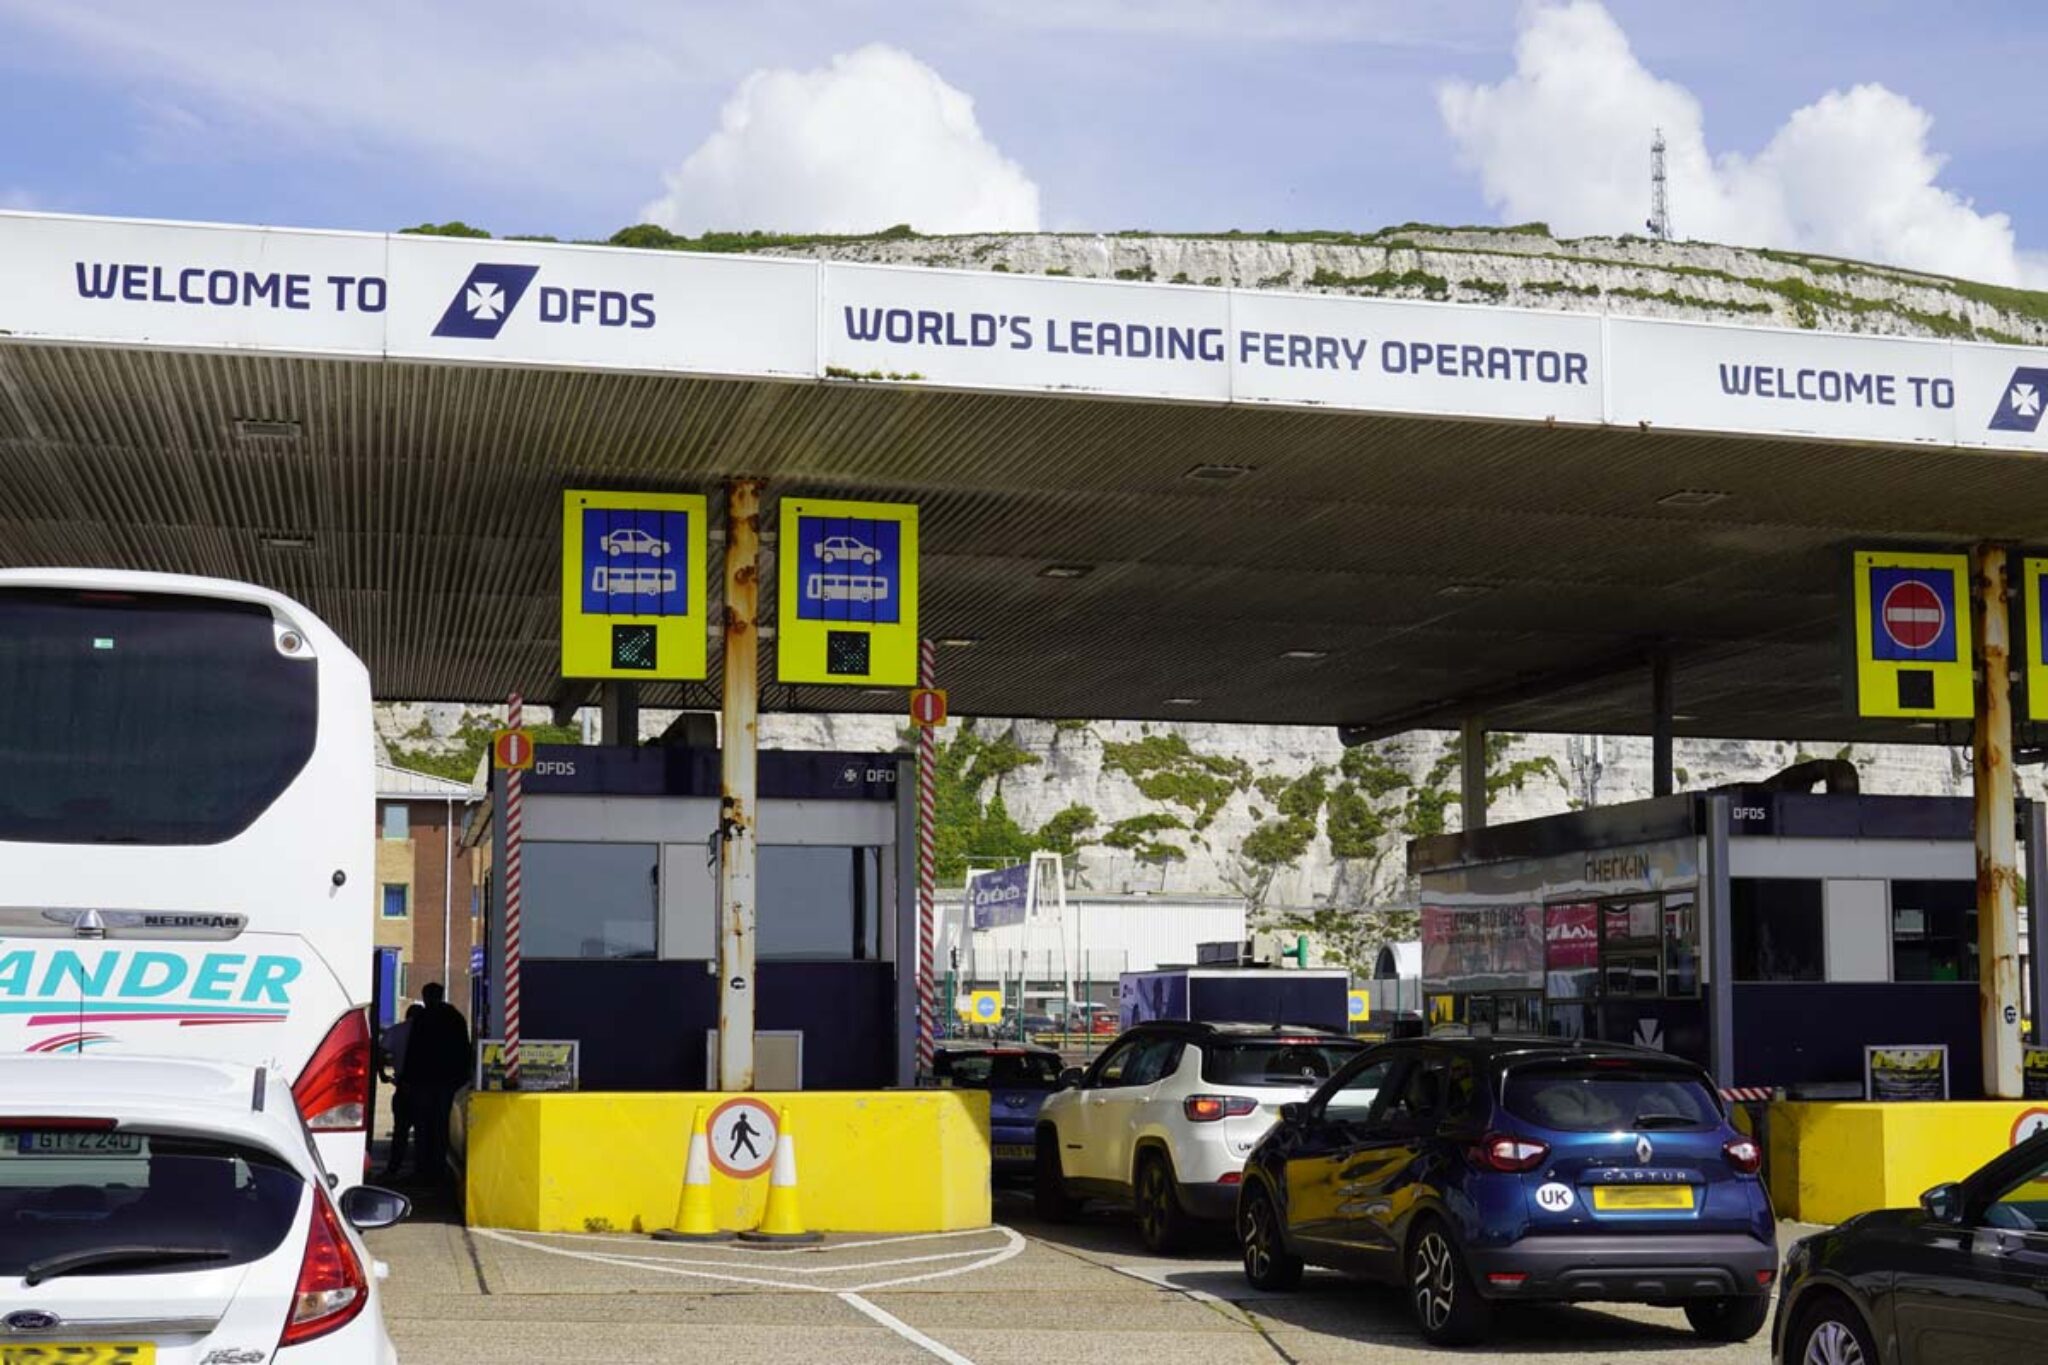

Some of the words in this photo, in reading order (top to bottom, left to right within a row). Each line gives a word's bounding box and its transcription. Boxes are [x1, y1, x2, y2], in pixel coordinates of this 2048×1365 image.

[76, 263, 311, 311] WELCOME
[328, 276, 386, 313] TO
[540, 287, 656, 329] DFDS
[844, 307, 1032, 350] WORLD'S
[1048, 320, 1224, 362] LEADING
[1240, 332, 1367, 371] FERRY
[1381, 342, 1588, 385] OPERATOR
[1719, 363, 1896, 406] WELCOME
[1907, 377, 1955, 409] TO
[535, 762, 576, 775] DFDS
[866, 769, 896, 782] DFD
[1733, 806, 1766, 820] DFDS
[1603, 1171, 1686, 1180] CAPTUR
[1541, 1190, 1568, 1206] UK
